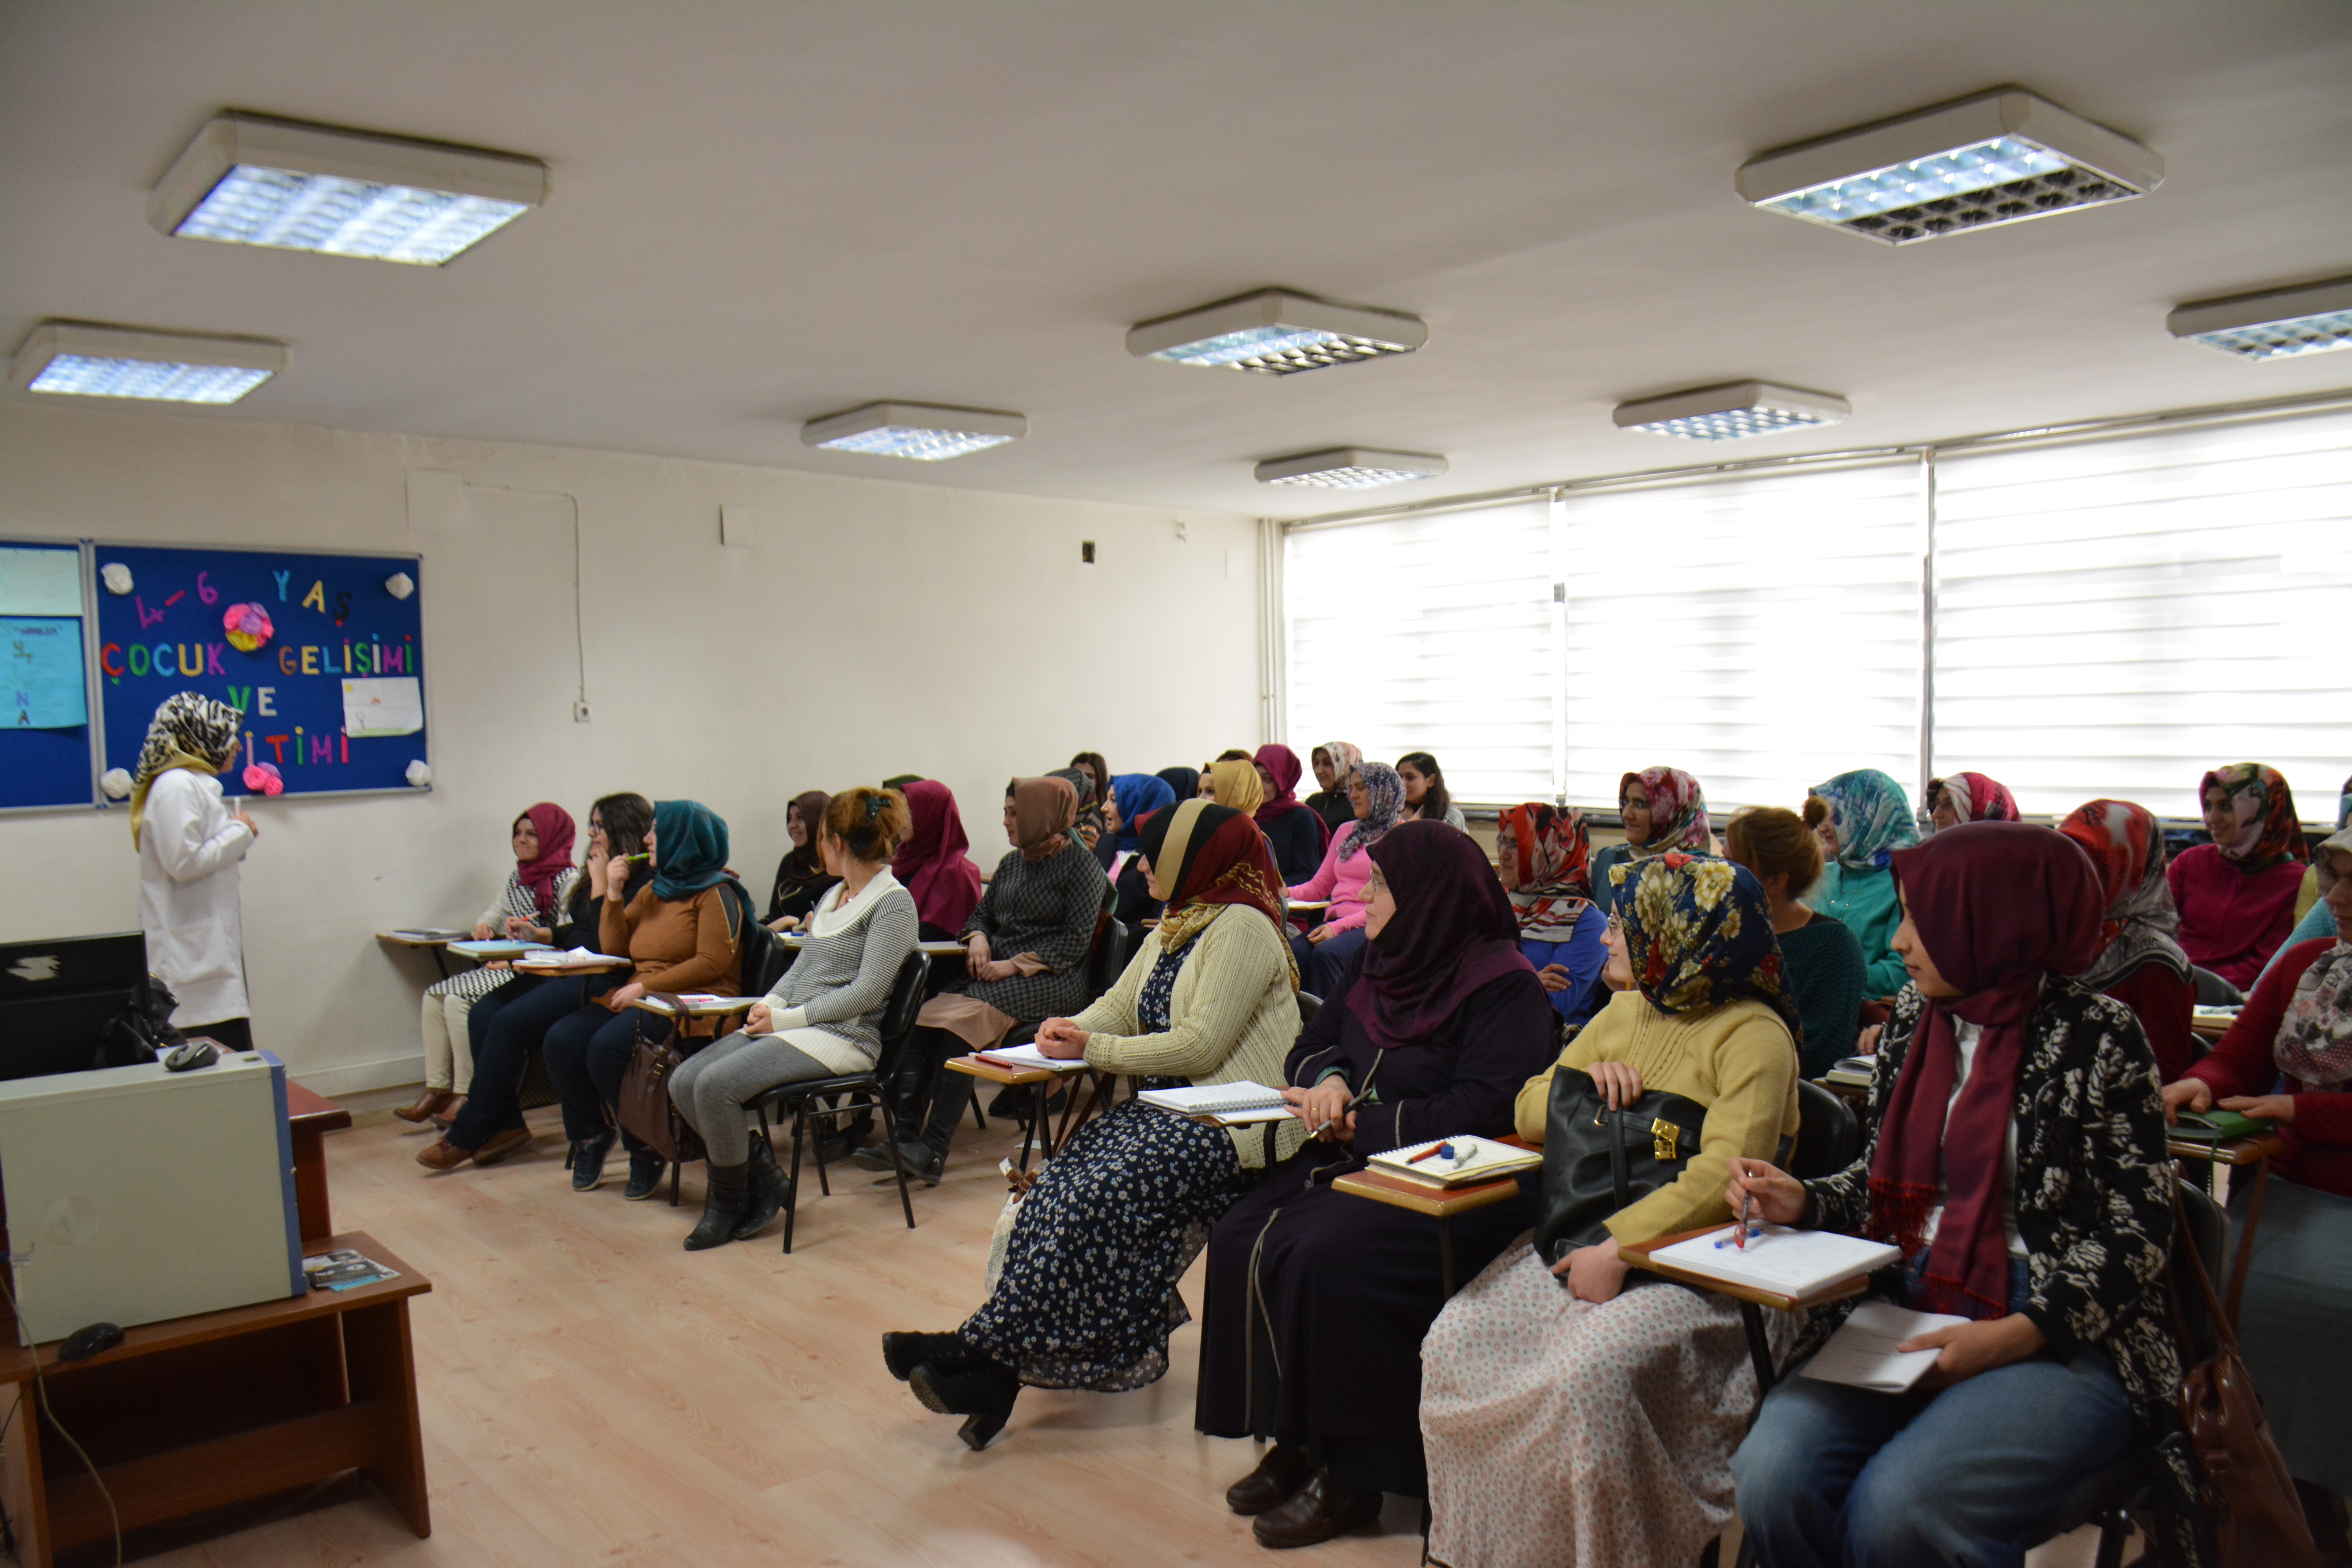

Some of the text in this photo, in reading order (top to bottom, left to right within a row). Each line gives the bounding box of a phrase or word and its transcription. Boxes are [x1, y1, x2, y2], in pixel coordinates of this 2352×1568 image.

[272, 570, 352, 627] YAŞ
[101, 642, 226, 685] ÇOCUK
[227, 685, 278, 717] VE
[245, 726, 348, 766] İTİMİ
